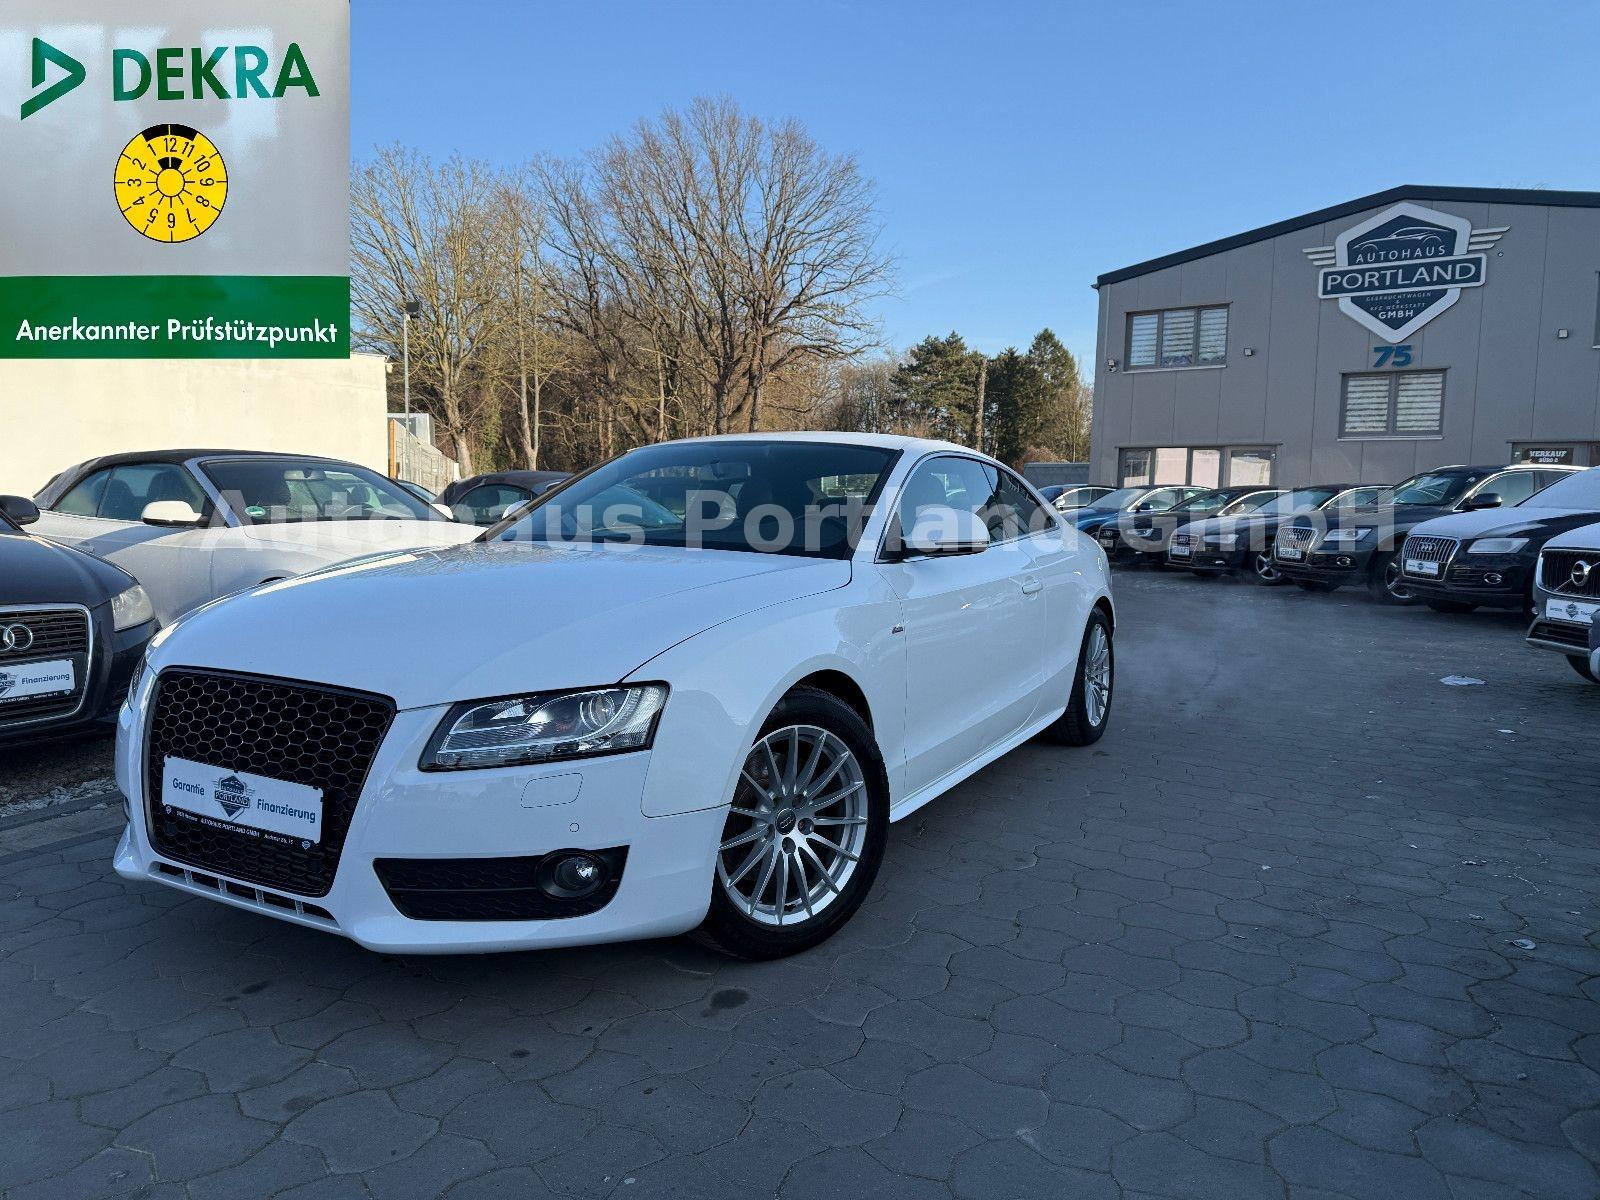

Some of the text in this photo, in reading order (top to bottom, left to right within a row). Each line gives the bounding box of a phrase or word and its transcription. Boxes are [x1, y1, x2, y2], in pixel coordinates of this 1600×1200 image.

[1355, 244, 1446, 264] AUTOHAUS
[1326, 262, 1476, 291] PORTLAND
[1366, 292, 1432, 302] GEBRAUCHTWAGEN
[1378, 309, 1414, 319] GMBH
[1373, 345, 1414, 368] 75
[21, 673, 70, 685] Finanzierung
[172, 777, 205, 796] Garantie
[256, 798, 316, 824] Finanzierung
